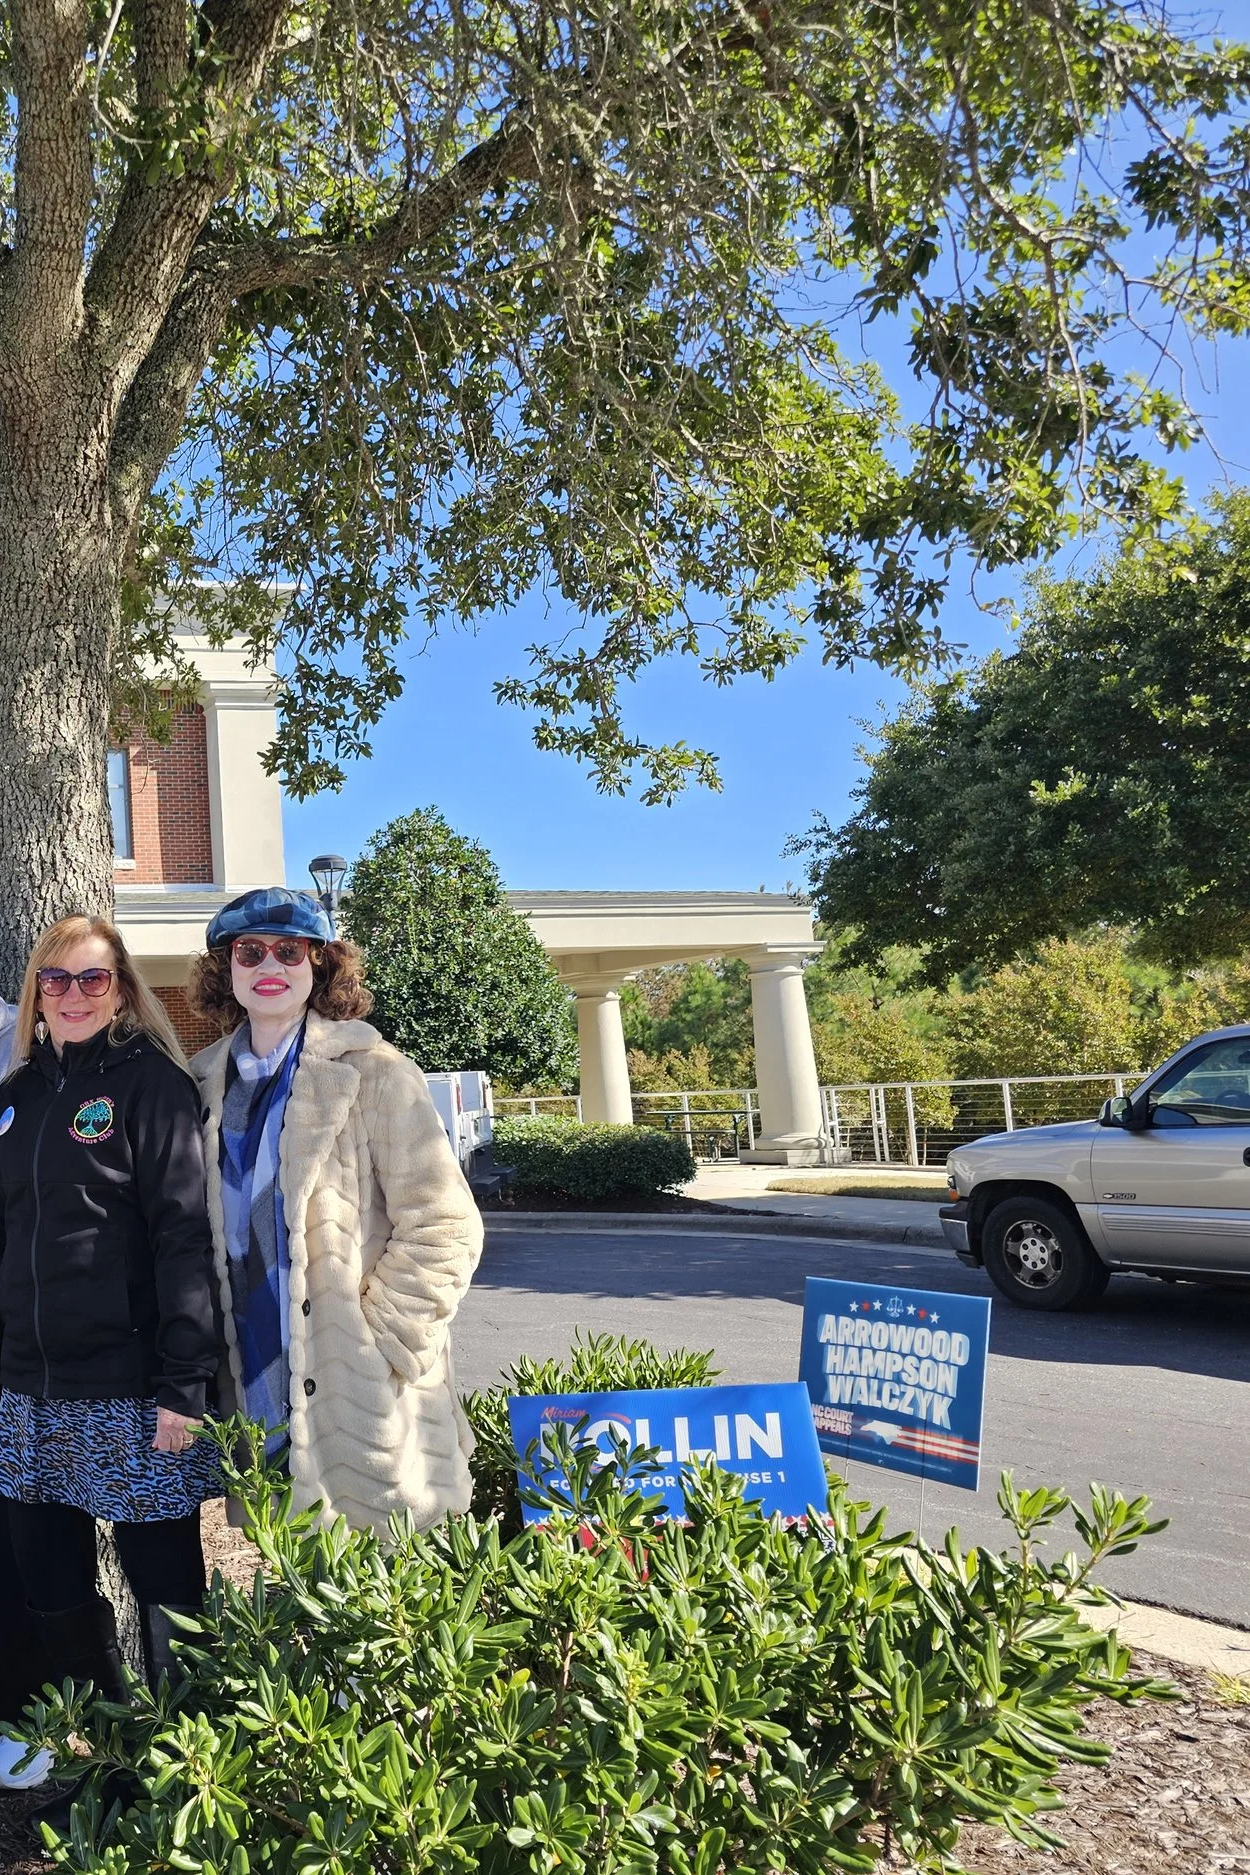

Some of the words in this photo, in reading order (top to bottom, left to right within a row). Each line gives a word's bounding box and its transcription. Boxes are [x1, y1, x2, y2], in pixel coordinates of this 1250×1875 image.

[68, 1127, 98, 1144] Adventure
[99, 1129, 115, 1142] Club
[818, 1314, 971, 1367] ARROWOOD
[824, 1344, 959, 1398] HAMPSON
[826, 1375, 954, 1430] WALCZYK
[541, 1406, 586, 1419] Miriam
[824, 1406, 854, 1424] COURT
[641, 1476, 676, 1488] FOR
[778, 1471, 786, 1483] 1
